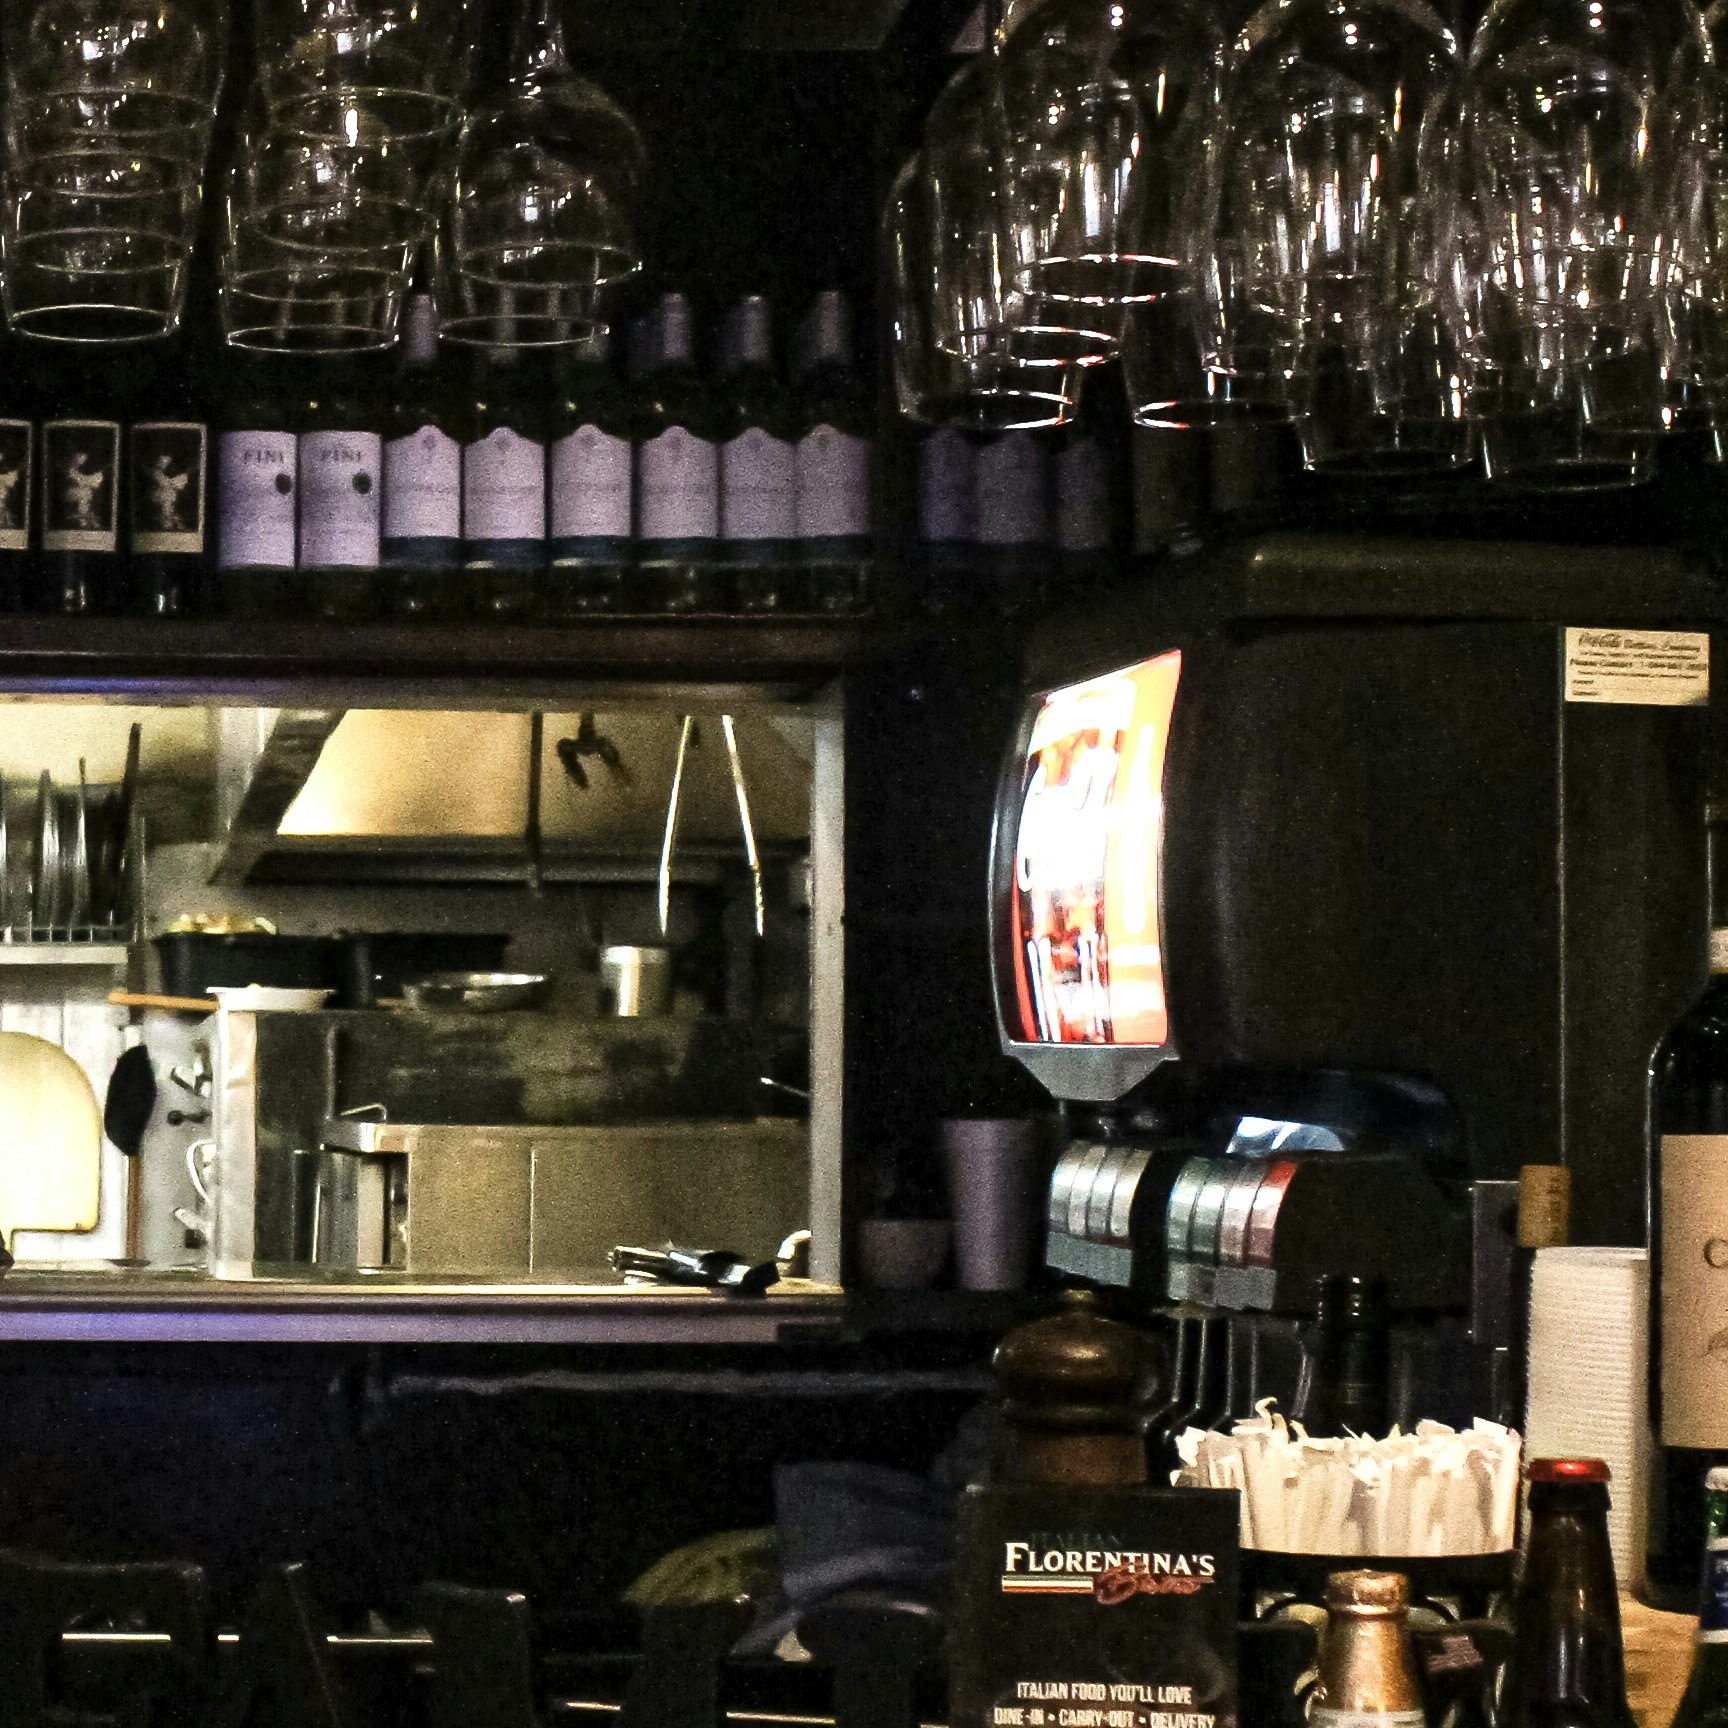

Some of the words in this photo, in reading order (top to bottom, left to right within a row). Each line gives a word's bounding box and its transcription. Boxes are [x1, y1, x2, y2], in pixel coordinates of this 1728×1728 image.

[1005, 1541, 1216, 1577] FLORENTINA'S
[1017, 1682, 1068, 1700] ITALIAN
[1071, 1683, 1105, 1701] FOOD
[1109, 1685, 1154, 1703] YOU'LL
[1158, 1687, 1192, 1705] LOVE
[994, 1707, 1044, 1726] DINE-IN
[1059, 1709, 1134, 1728] CARRY-OUT
